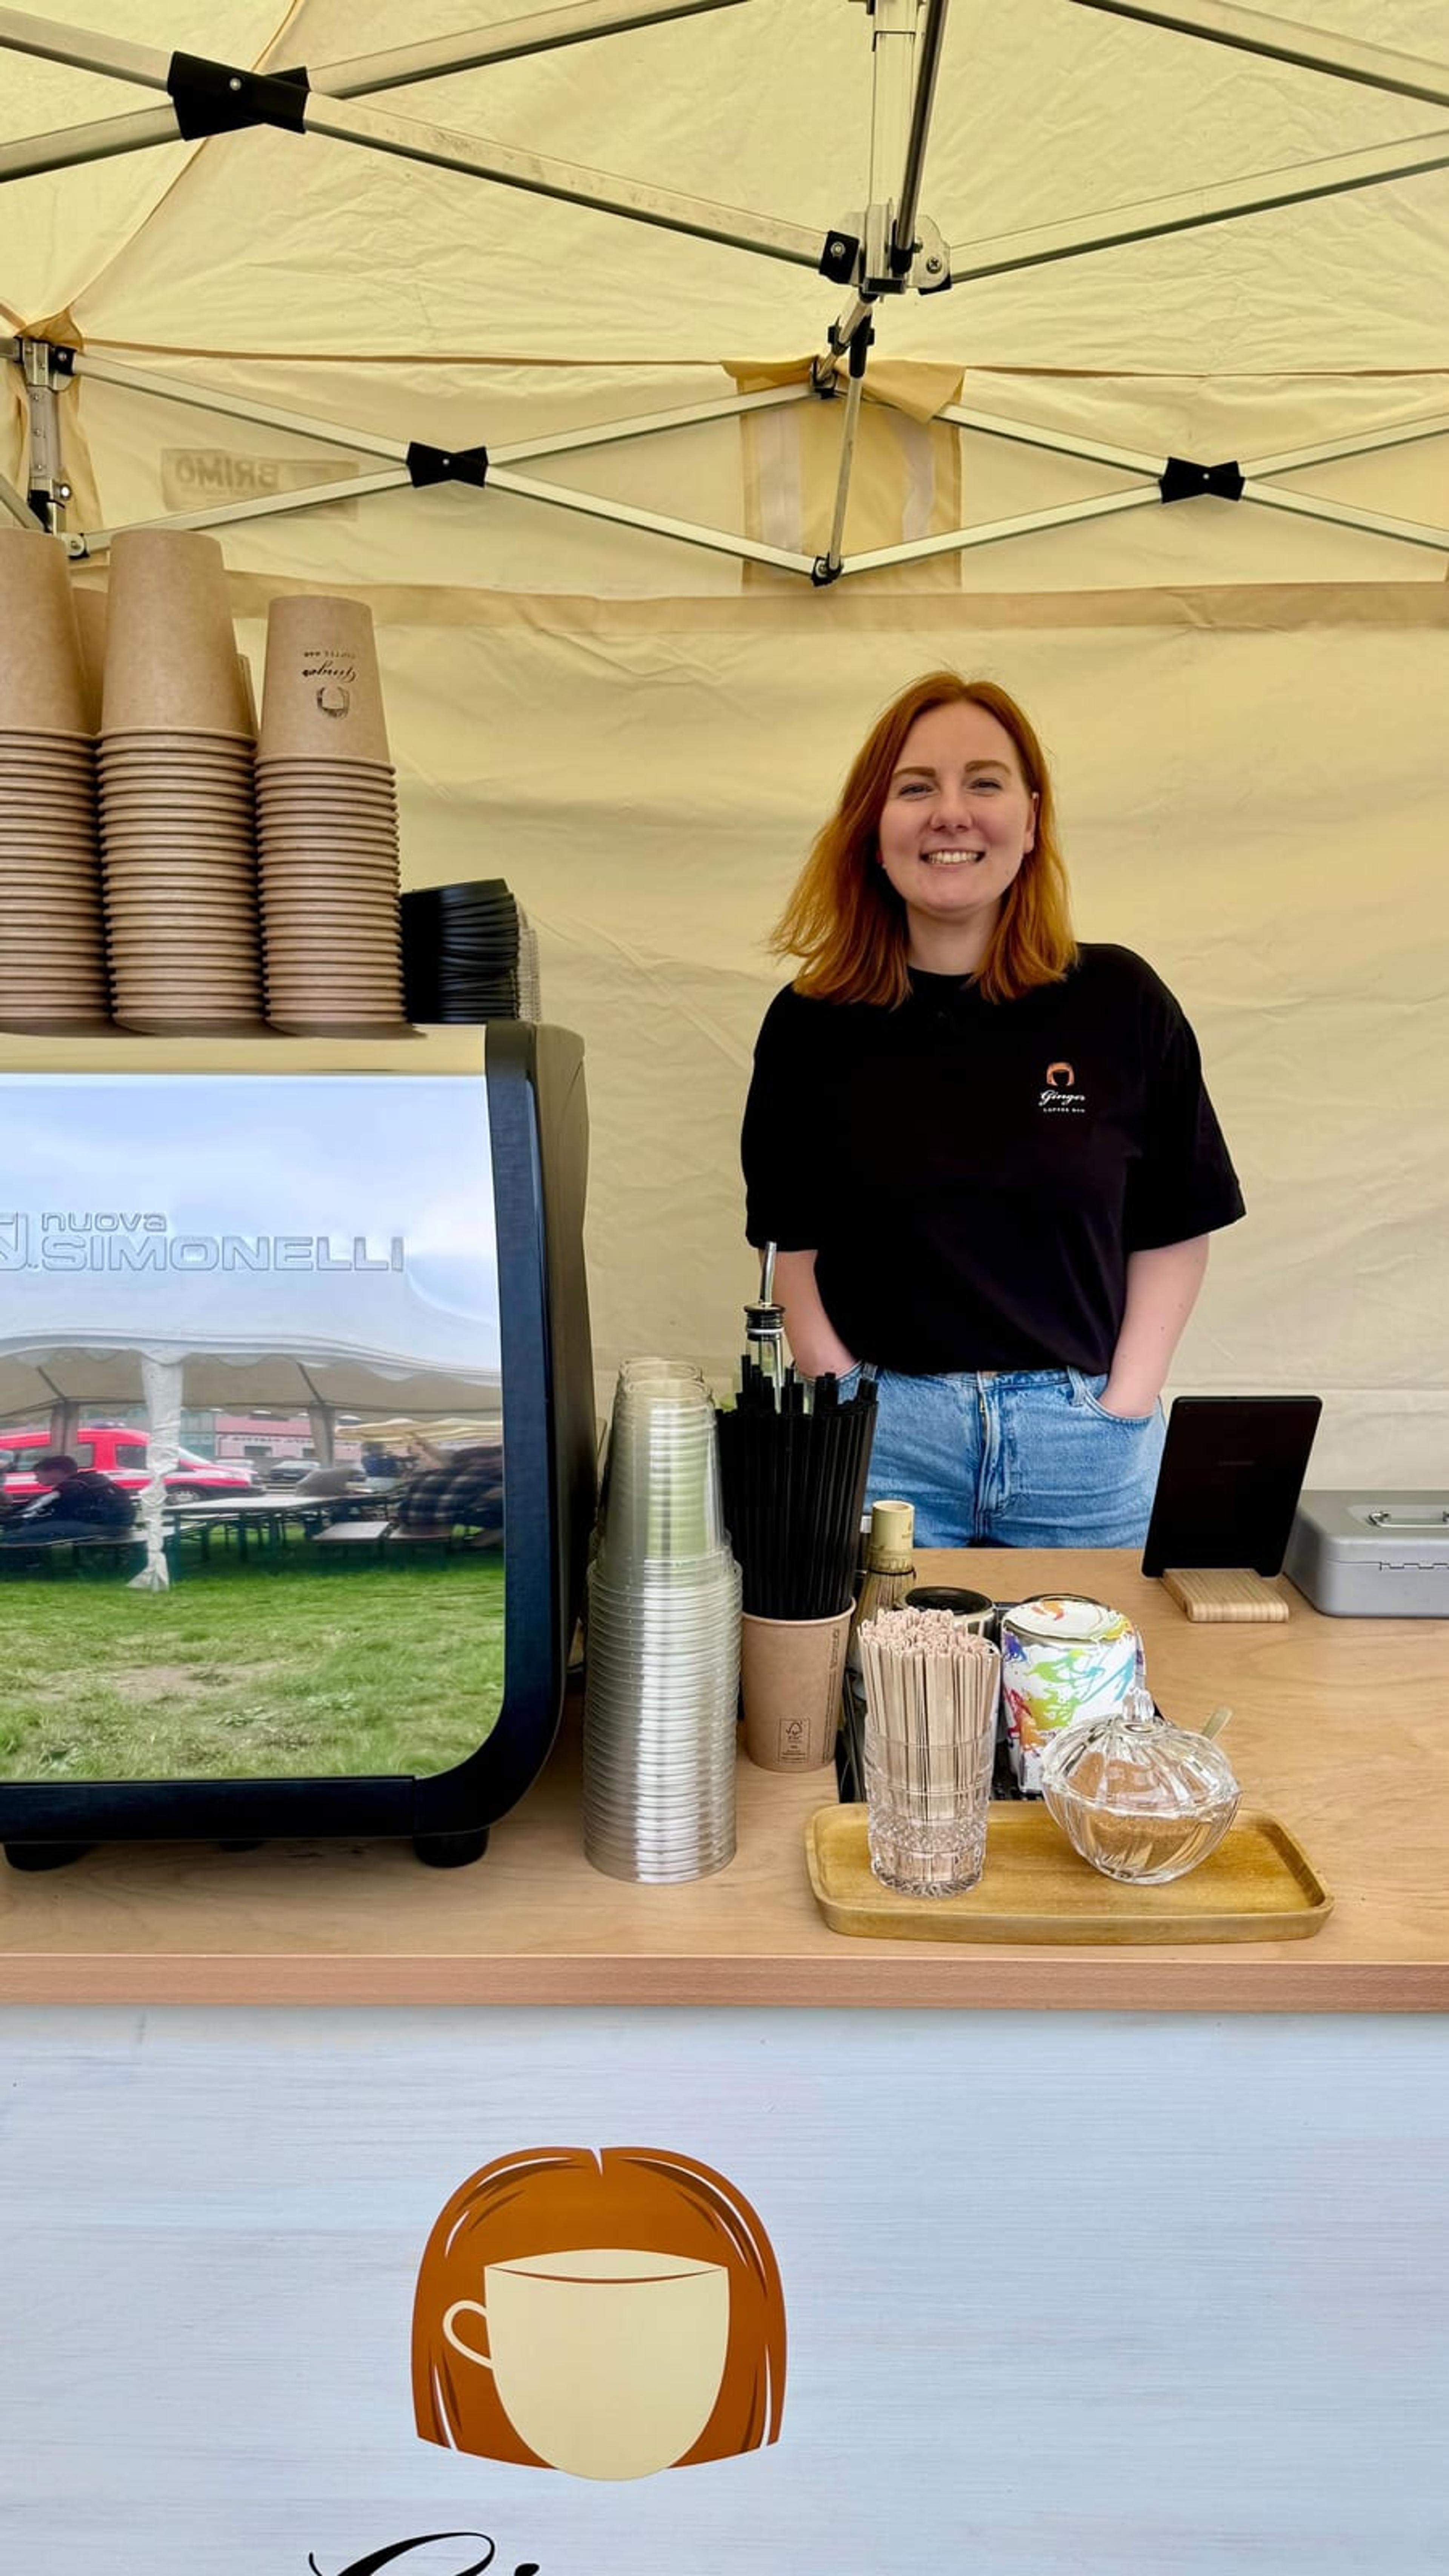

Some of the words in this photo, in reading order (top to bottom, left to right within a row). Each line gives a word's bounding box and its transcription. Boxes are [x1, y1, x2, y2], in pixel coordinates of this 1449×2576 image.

[302, 660, 357, 683] Ginger
[1038, 1089, 1086, 1106] Ginger
[41, 1212, 167, 1232] nuova
[41, 1235, 405, 1272] SIMONELLI
